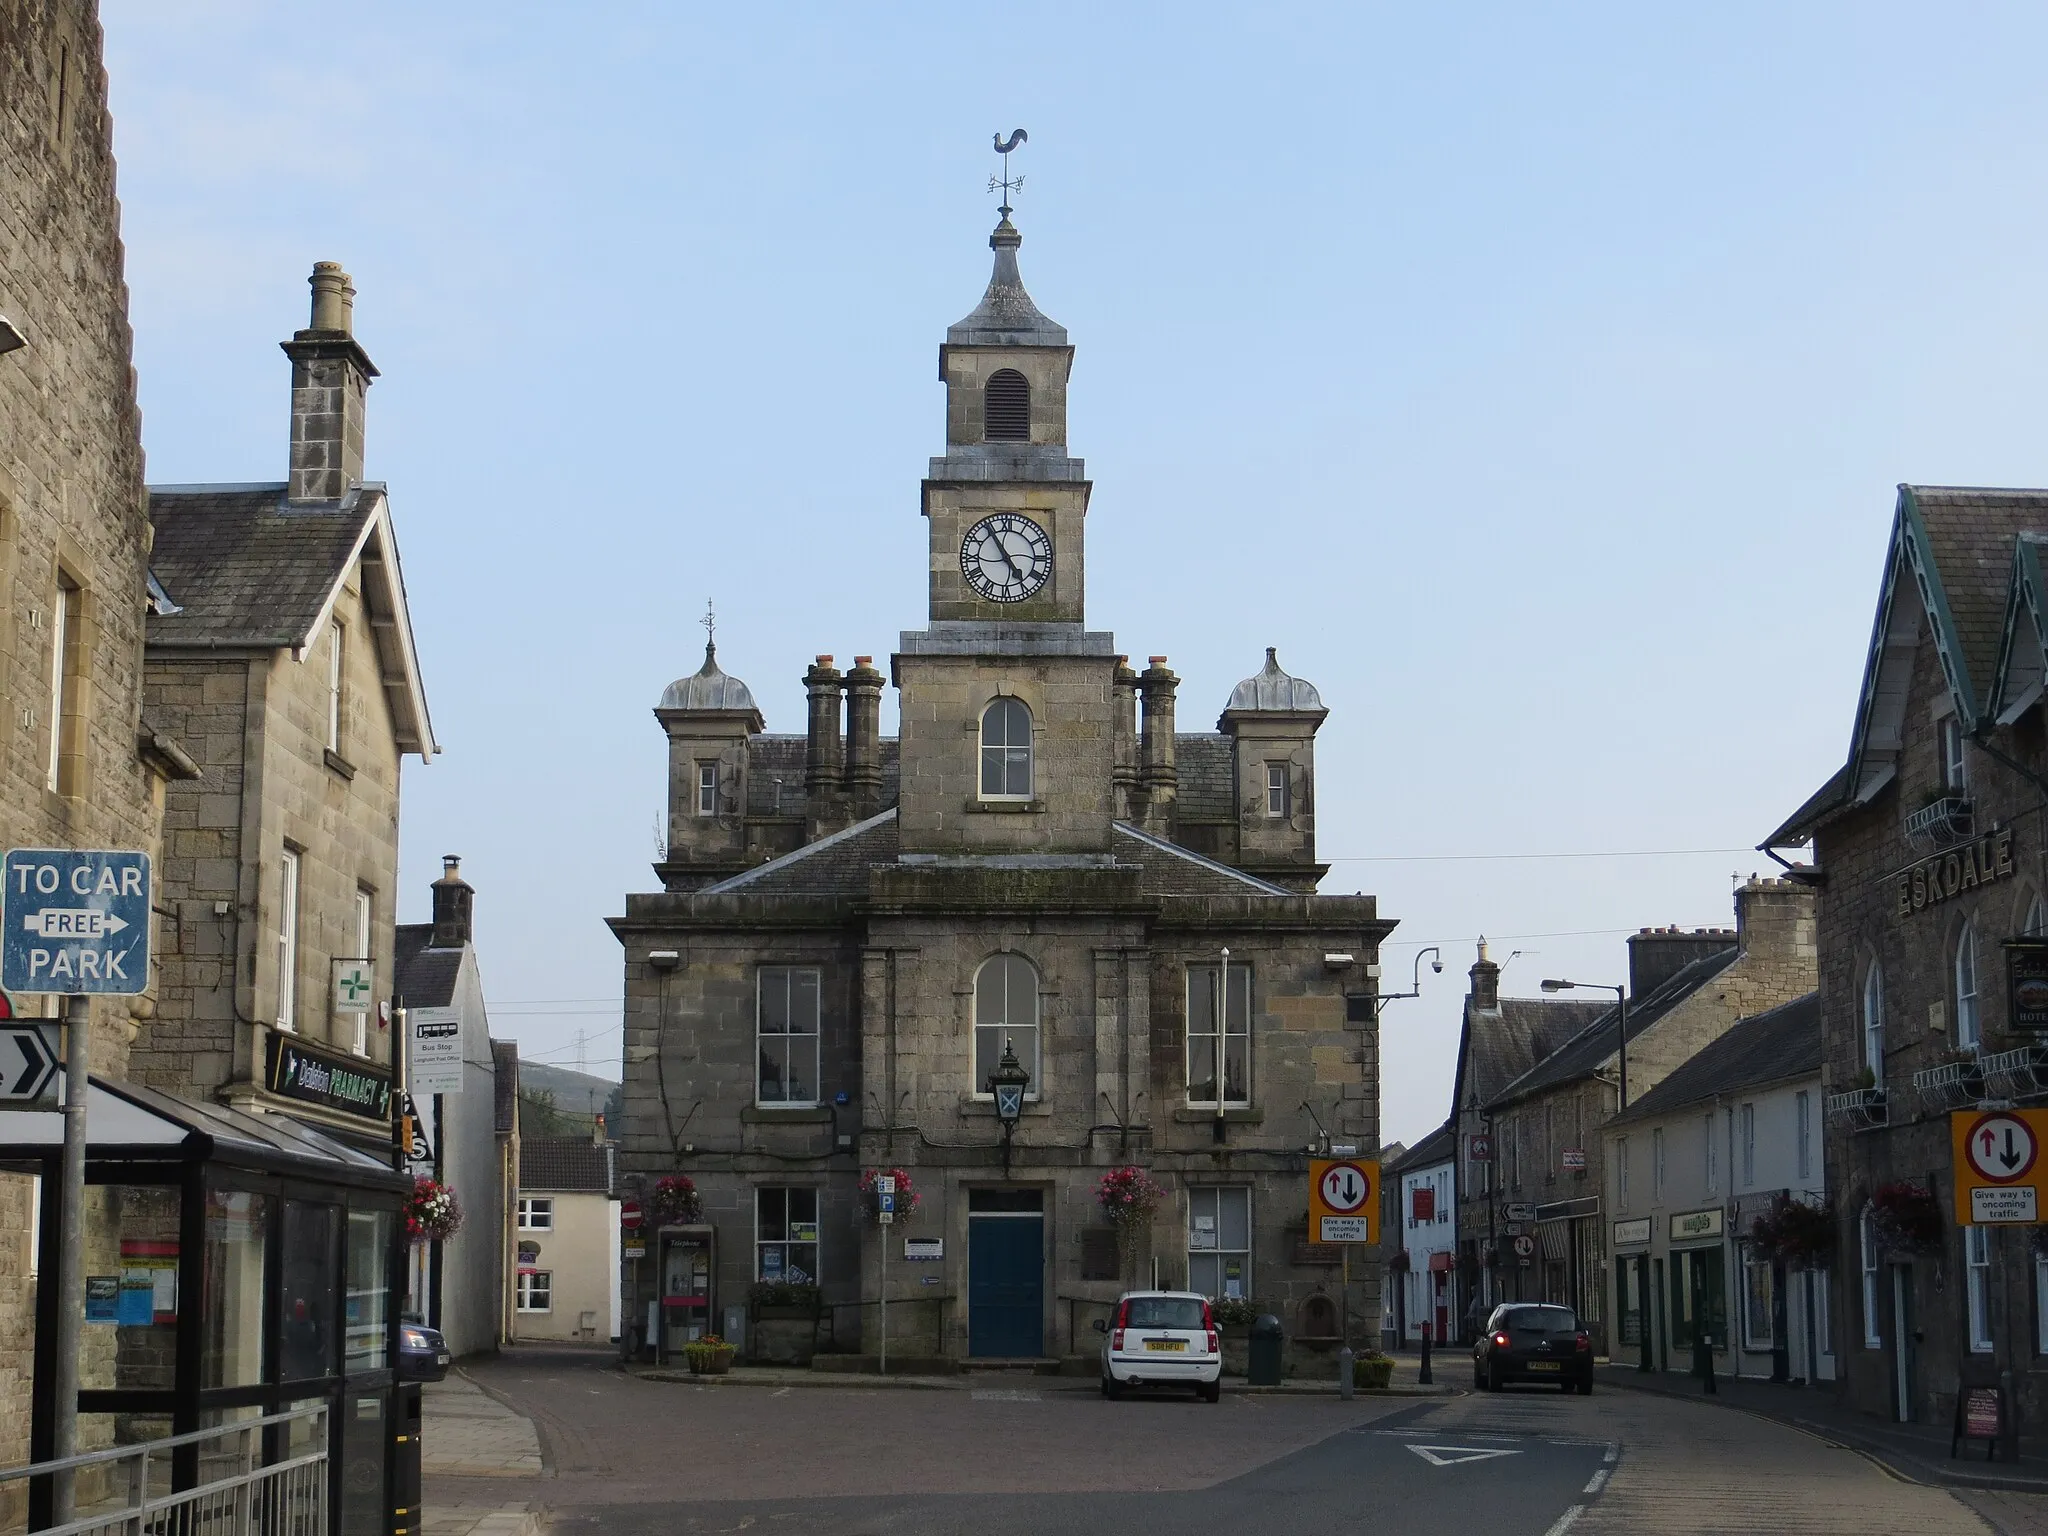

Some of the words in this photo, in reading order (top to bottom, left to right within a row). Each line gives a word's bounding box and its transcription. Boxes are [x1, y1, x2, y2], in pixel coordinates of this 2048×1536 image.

[12, 864, 60, 894] TO
[71, 865, 144, 896] CAR
[1896, 827, 2012, 916] ESKDALE
[44, 914, 101, 934] FREE
[30, 948, 129, 980] PARK
[298, 1058, 330, 1092] Dalston
[329, 1068, 378, 1105] PHARMACY
[882, 1196, 892, 1209] P
[1974, 1190, 1994, 1199] Give
[1999, 1192, 2018, 1200] way
[2022, 1190, 2033, 1198] to
[1982, 1200, 2026, 1208] oncoming
[1989, 1209, 2019, 1218] traffic
